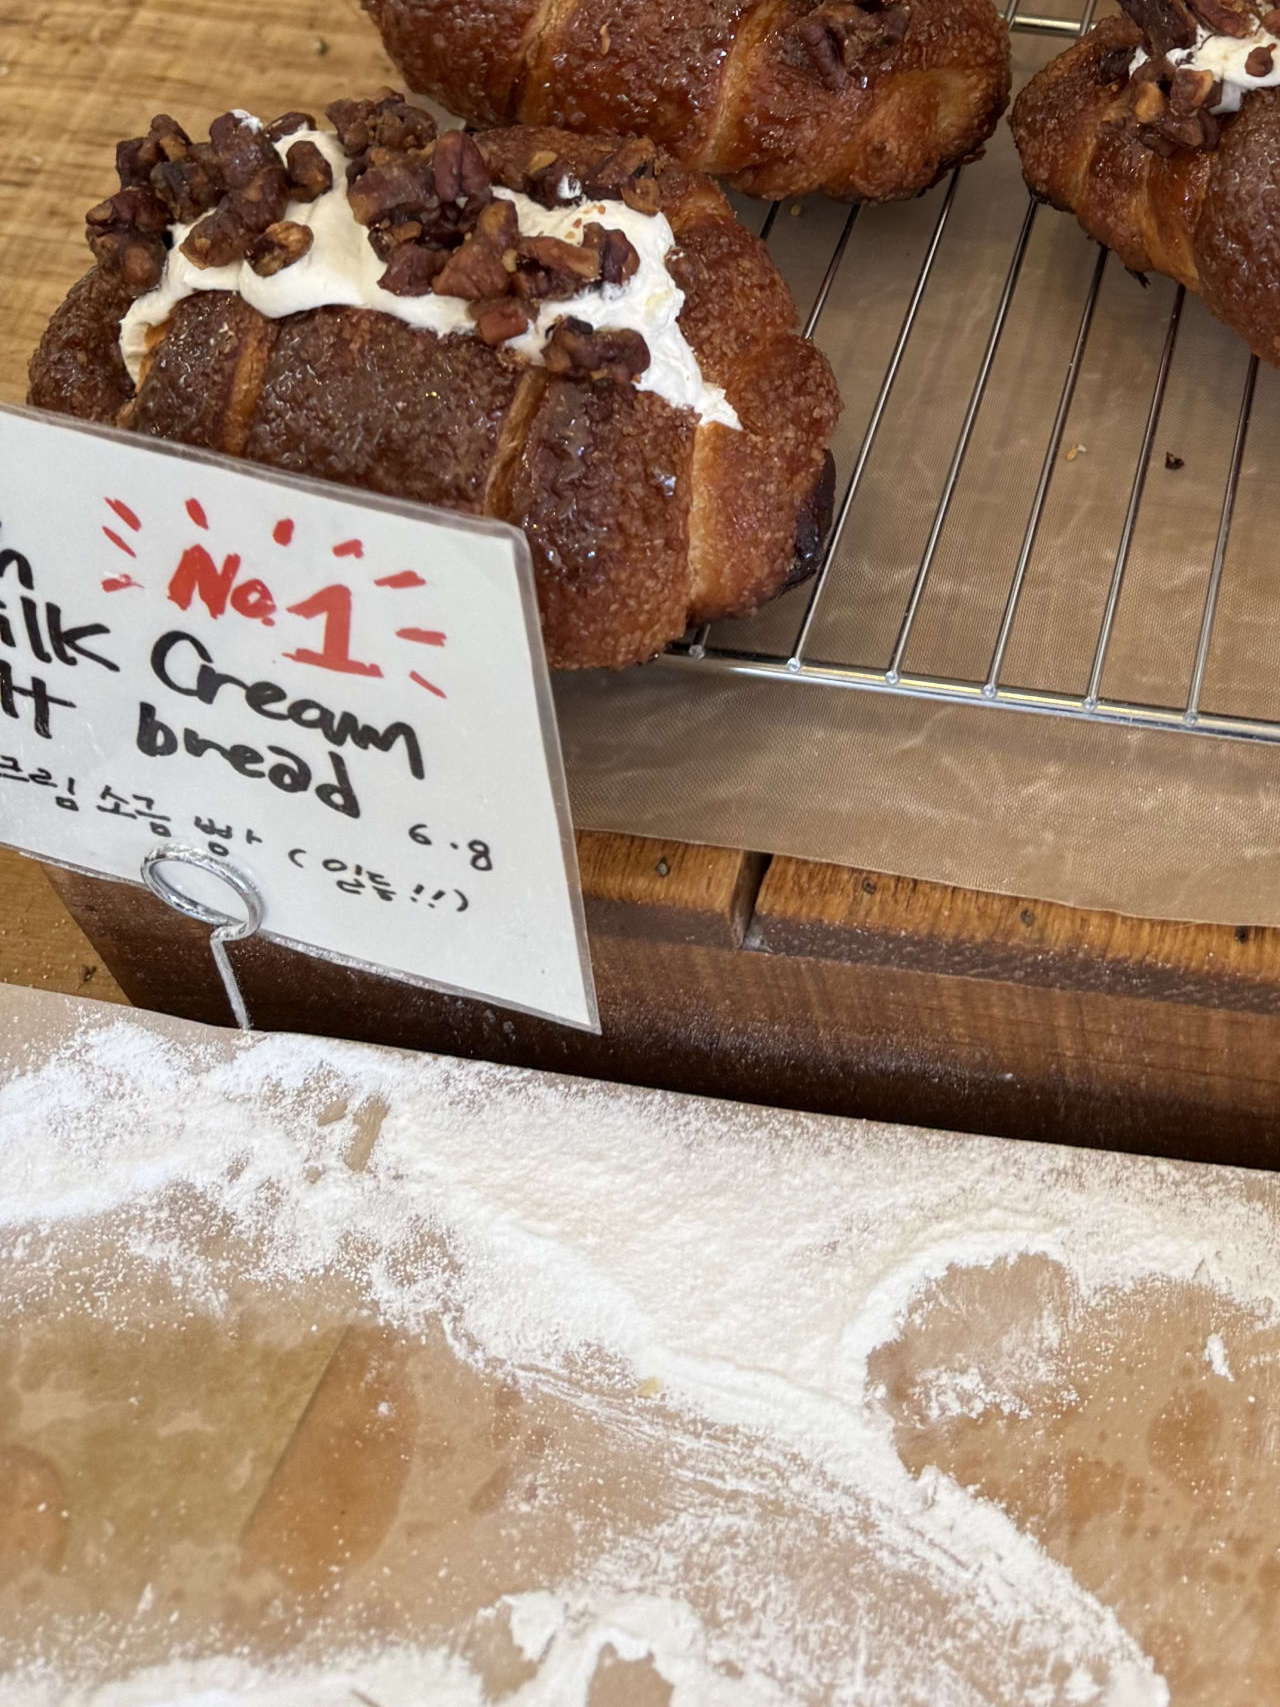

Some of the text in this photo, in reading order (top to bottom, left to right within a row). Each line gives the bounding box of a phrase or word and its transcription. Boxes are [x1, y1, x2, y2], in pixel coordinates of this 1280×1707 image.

[0, 595, 425, 780] ilk Cream
[138, 702, 361, 818] bread
[408, 823, 493, 871] 6.8
